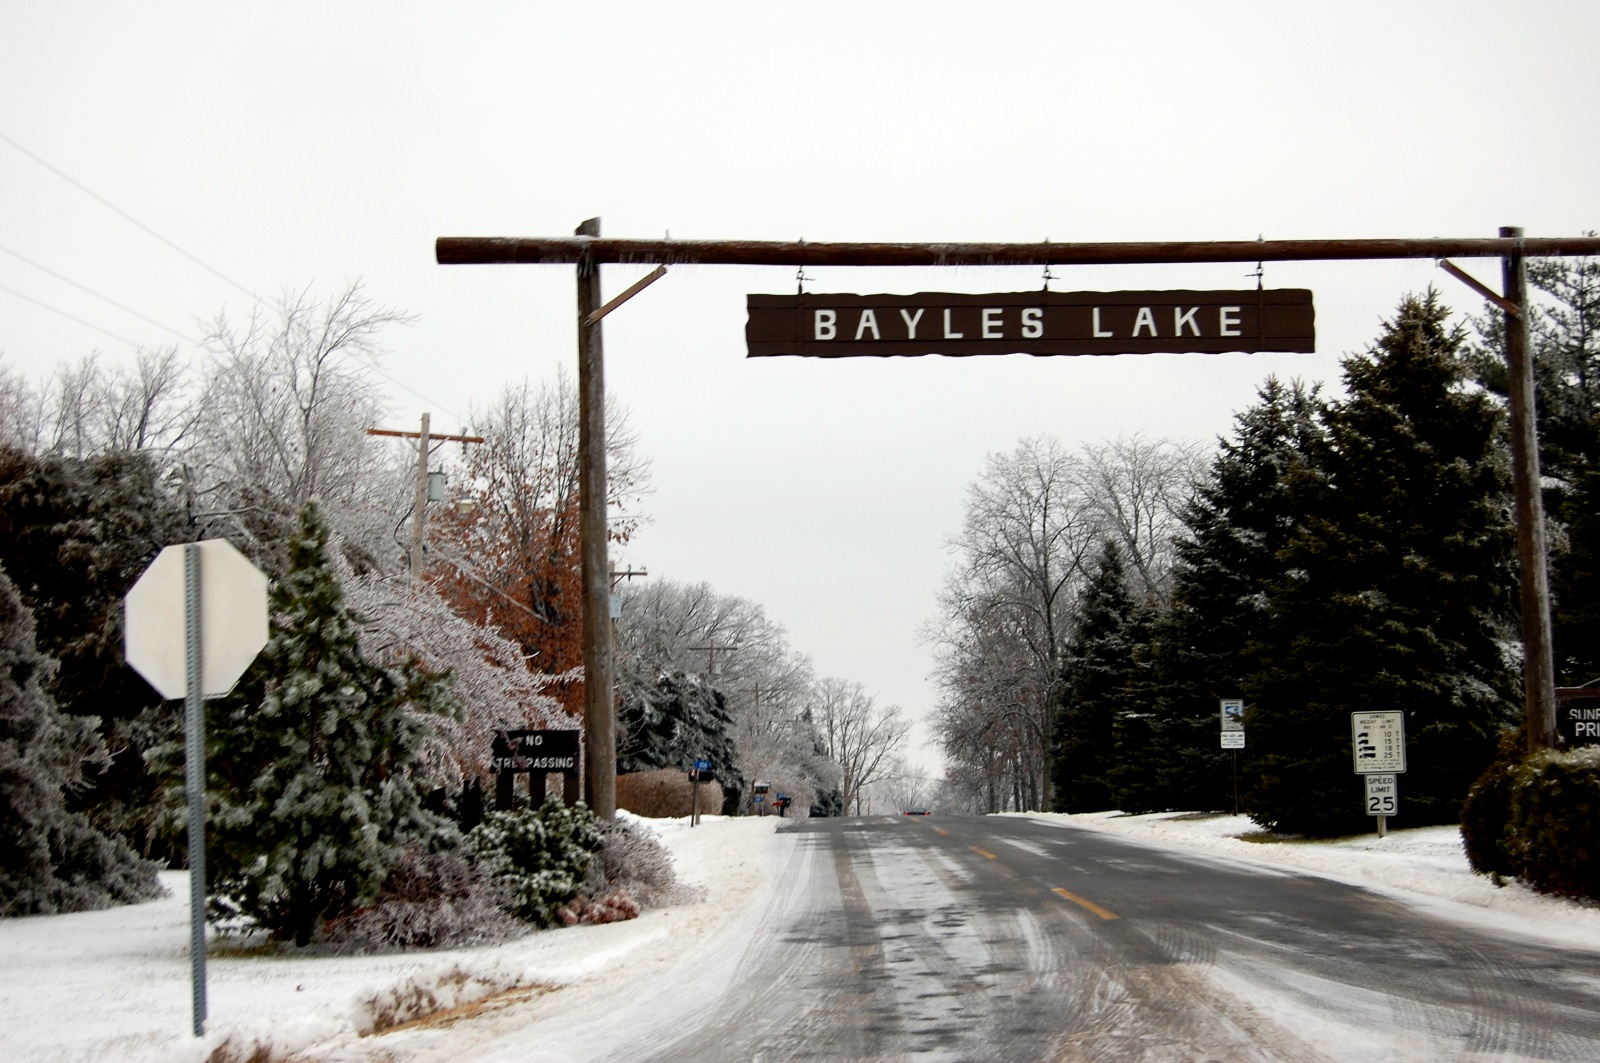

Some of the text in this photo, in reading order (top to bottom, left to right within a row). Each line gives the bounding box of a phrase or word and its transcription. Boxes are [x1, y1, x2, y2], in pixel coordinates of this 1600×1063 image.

[814, 306, 1242, 341] BAYLES LAKE
[1575, 722, 1600, 737] PRI
[525, 735, 543, 746] NO
[496, 757, 574, 769] TREPASSING
[1369, 796, 1394, 811] 25
